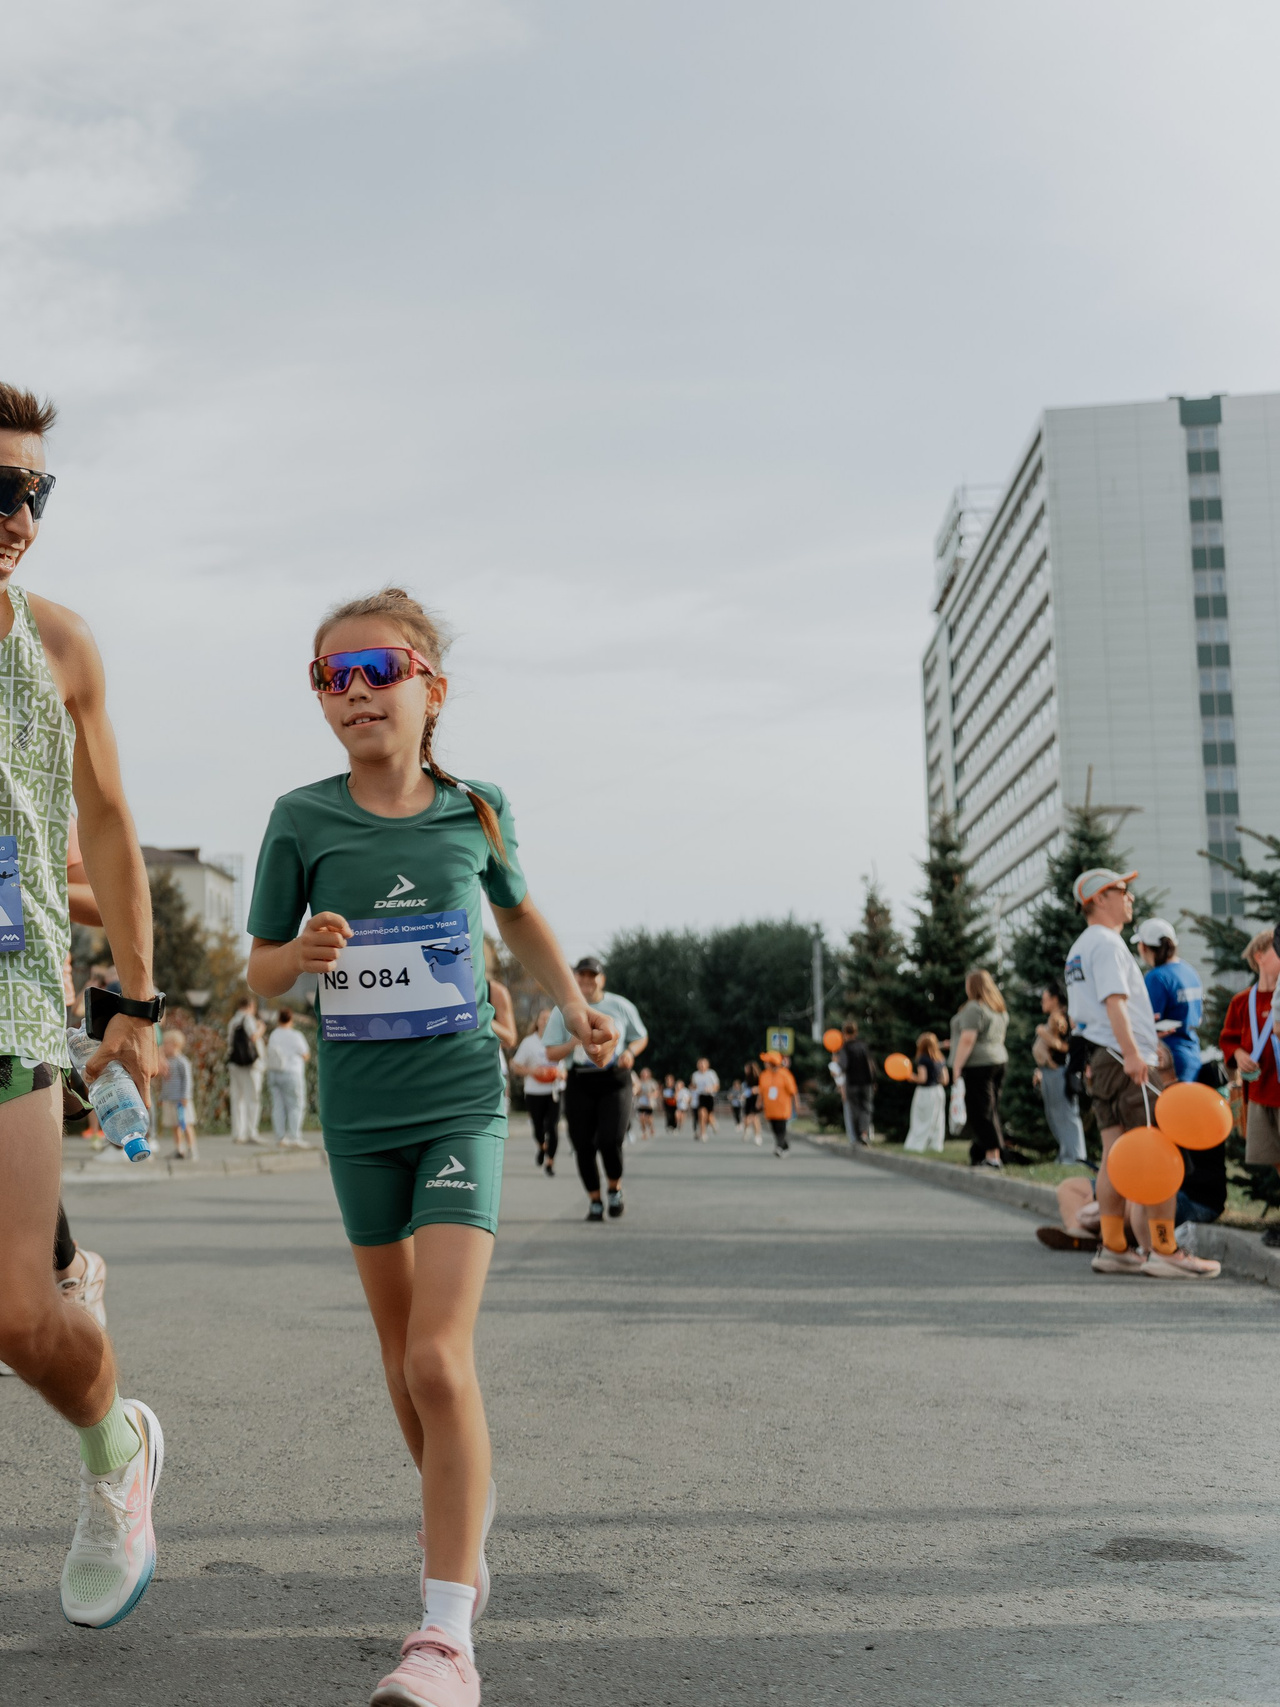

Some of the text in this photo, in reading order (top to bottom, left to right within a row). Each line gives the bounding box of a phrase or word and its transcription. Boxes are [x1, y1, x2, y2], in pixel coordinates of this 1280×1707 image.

[373, 898, 428, 909] DEMIX
[401, 923, 434, 933] Южного
[436, 919, 457, 929] Урала
[358, 967, 410, 989] 084
[425, 1179, 478, 1191] DEMIX
